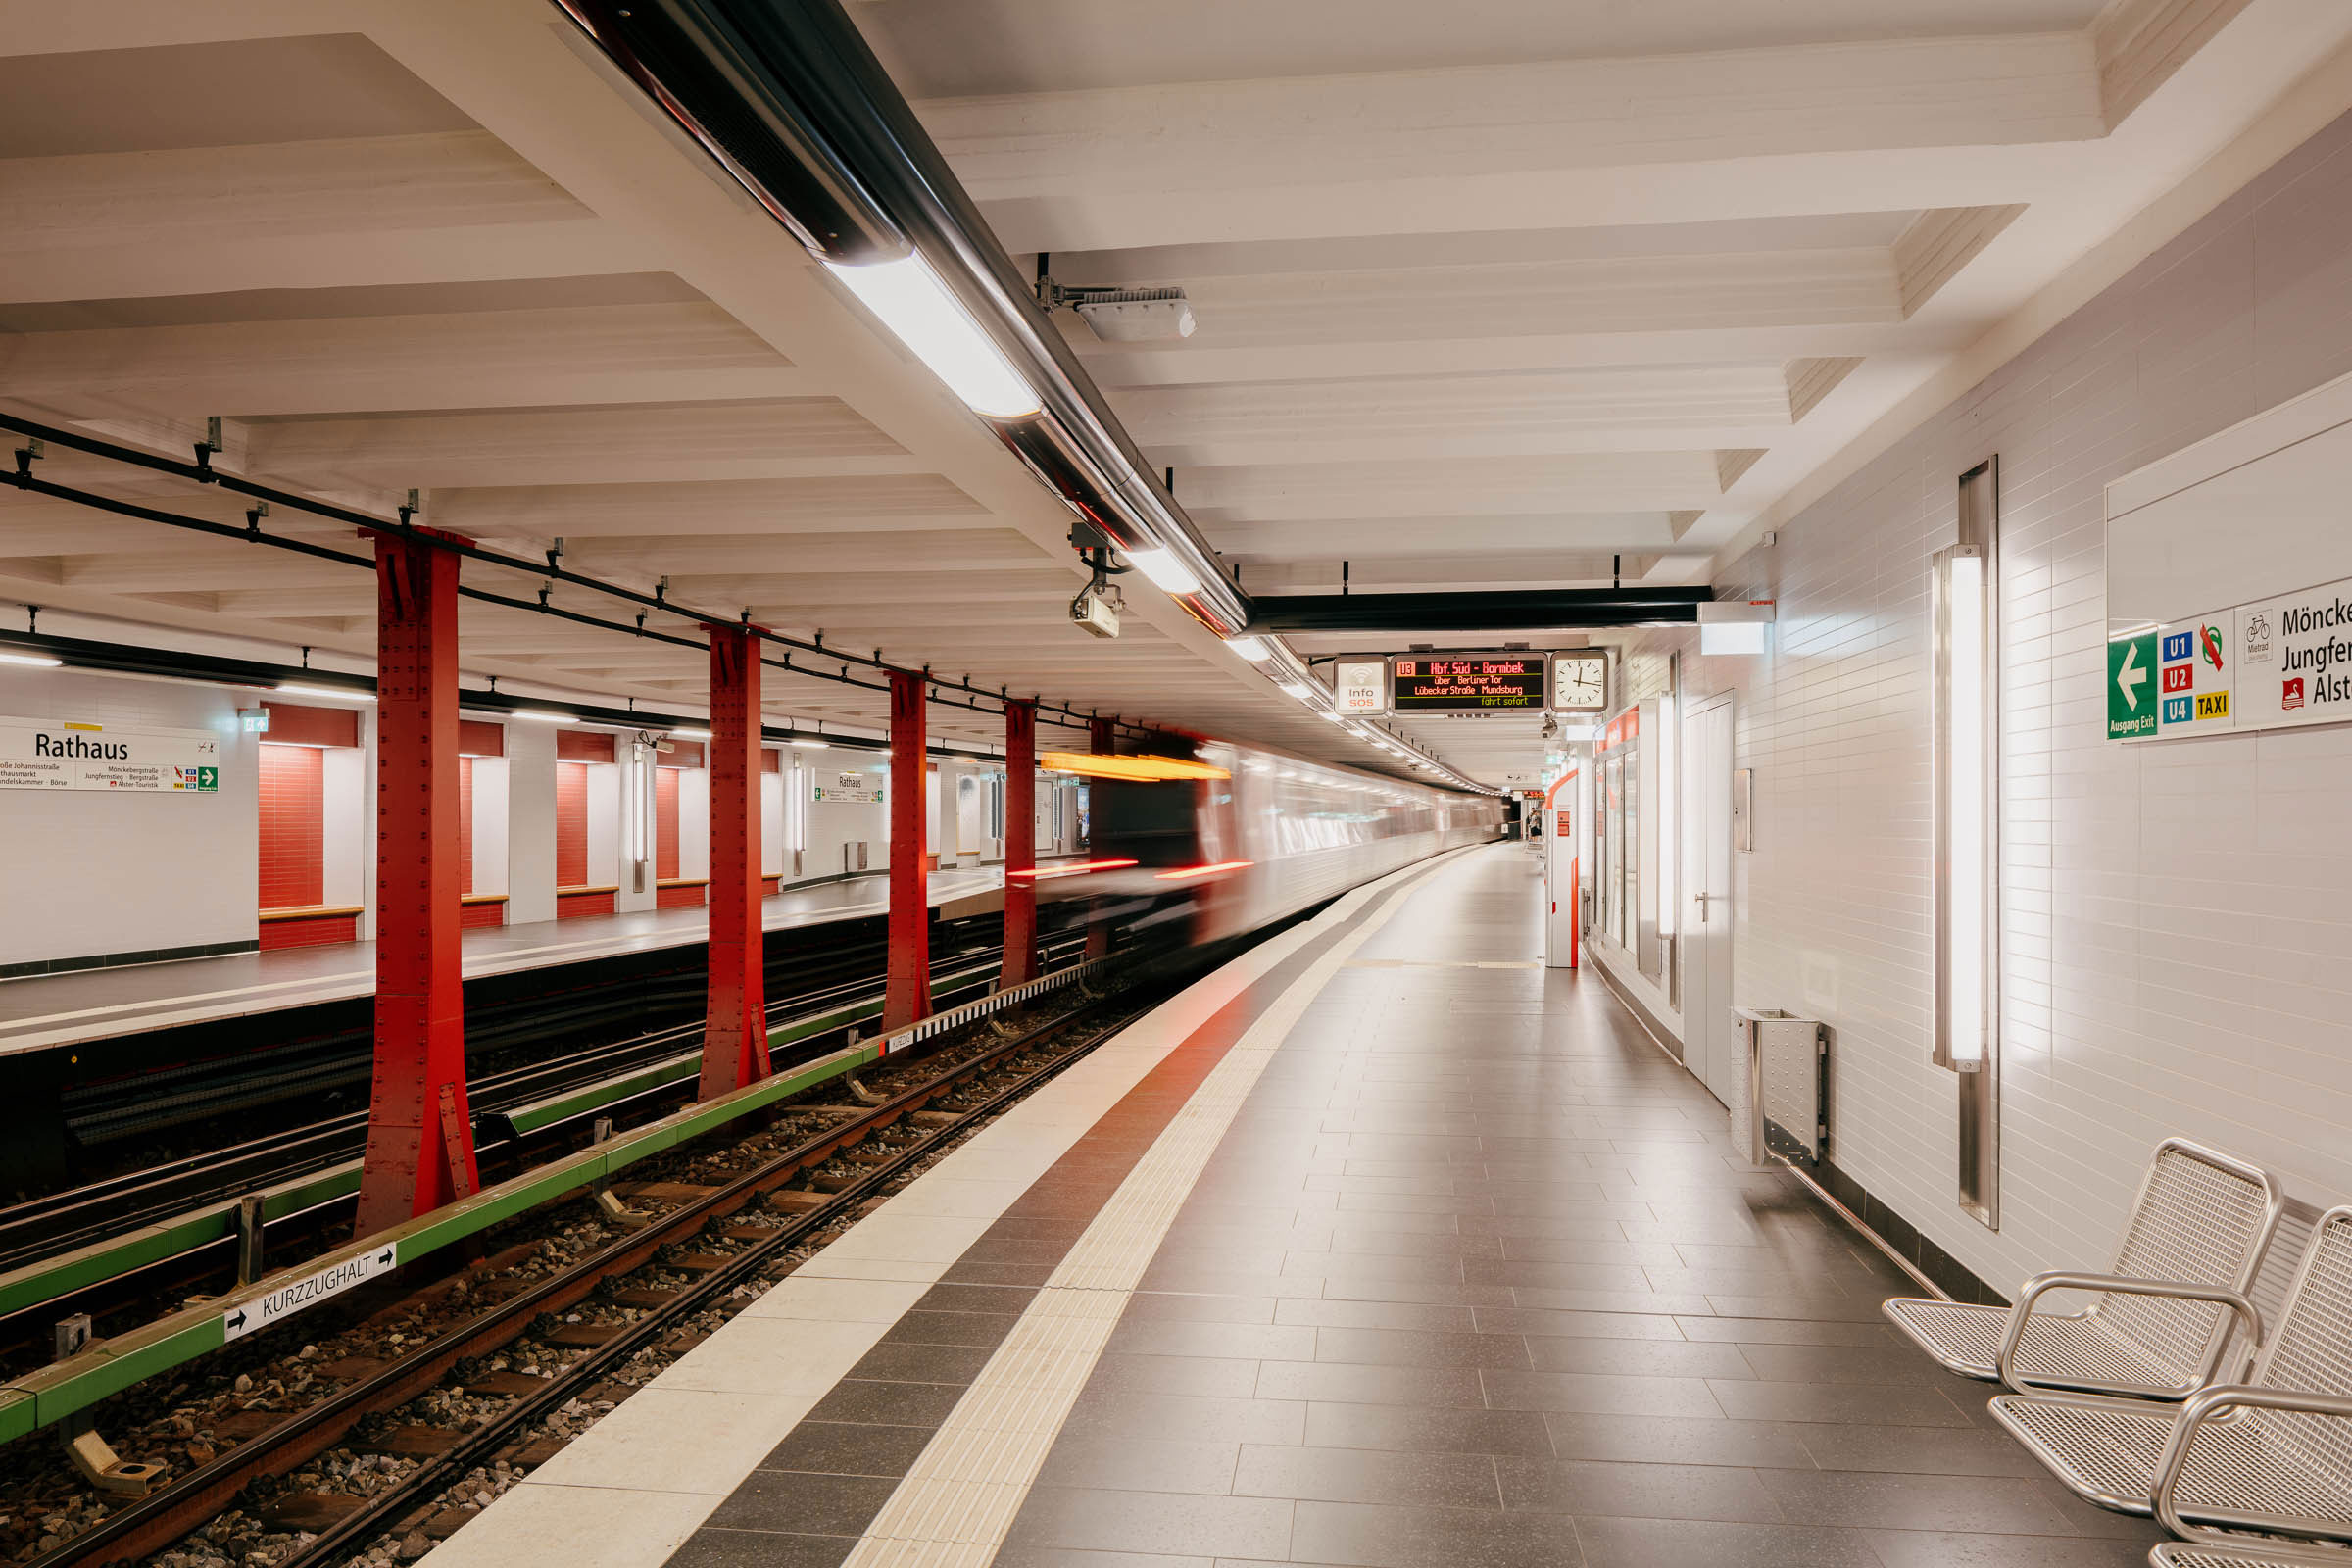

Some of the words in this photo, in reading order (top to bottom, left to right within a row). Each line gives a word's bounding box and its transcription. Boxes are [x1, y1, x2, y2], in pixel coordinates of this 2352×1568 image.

[2170, 637, 2185, 657] U1
[2248, 642, 2269, 654] Mietrad
[1431, 662, 1450, 675] Hbf.
[1452, 662, 1470, 674] Süd
[1434, 675, 1450, 685] über
[1457, 675, 1489, 685] Berliner
[1490, 675, 1503, 684] Tor
[2169, 669, 2186, 688] U2
[1348, 688, 1374, 698] Info
[1414, 685, 1449, 695] Lübecker
[1481, 685, 1523, 696] Mundsburg
[2314, 674, 2352, 704] Alst
[1348, 698, 1374, 707] SOS
[1481, 696, 1501, 706] fährt
[1502, 696, 1529, 706] sofort
[2198, 695, 2227, 715] TAXI
[2169, 701, 2186, 720] U4
[2111, 719, 2139, 734] Ausgang
[2140, 714, 2154, 728] Exit
[35, 733, 128, 760] Rathaus
[108, 765, 159, 775] Mönckebergstraße
[85, 772, 124, 781] Jungfernstieg
[839, 776, 861, 788] Rathaus
[263, 1255, 371, 1318] KURZZUGHALT
